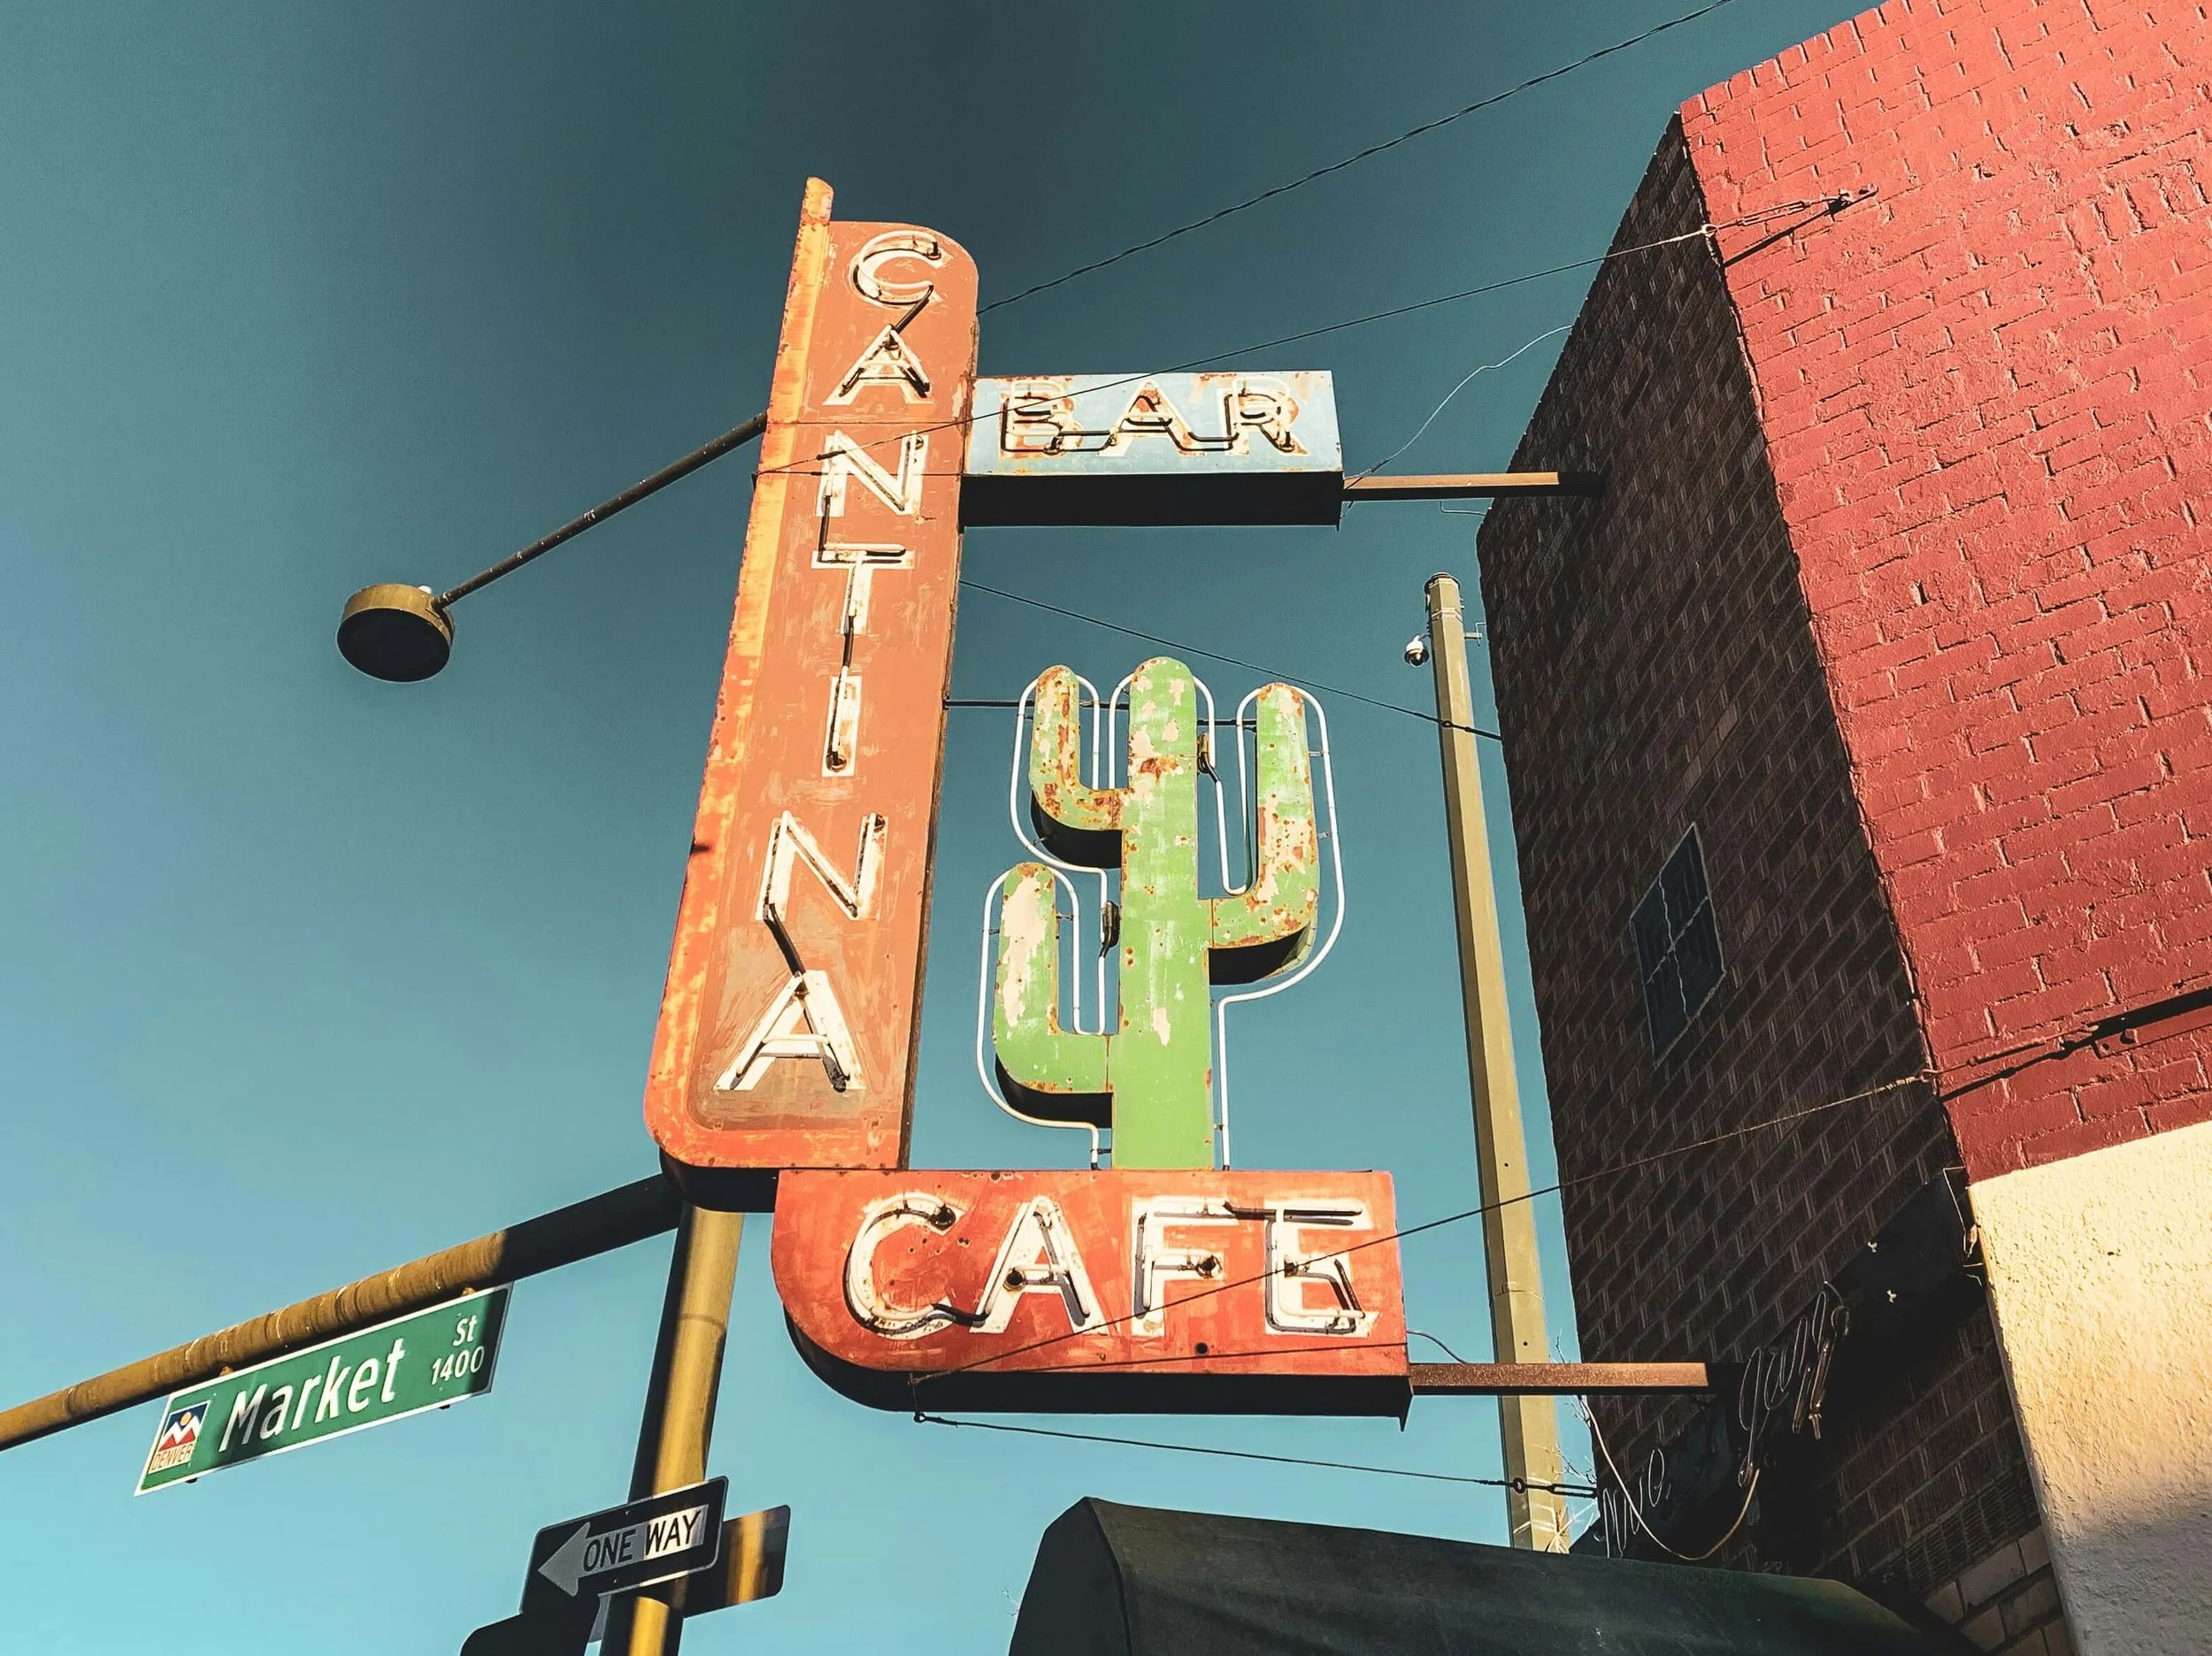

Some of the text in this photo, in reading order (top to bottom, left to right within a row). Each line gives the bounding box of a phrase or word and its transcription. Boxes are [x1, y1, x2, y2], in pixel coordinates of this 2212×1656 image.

[998, 376, 1310, 458] BAR
[711, 228, 953, 1093] CANTINA
[843, 1193, 1381, 1338] CAFE
[430, 1345, 486, 1385] 1400
[451, 1315, 478, 1346] St
[219, 1338, 405, 1452] Market
[151, 1443, 194, 1471] DENVER
[582, 1509, 702, 1573] ONE WAY
